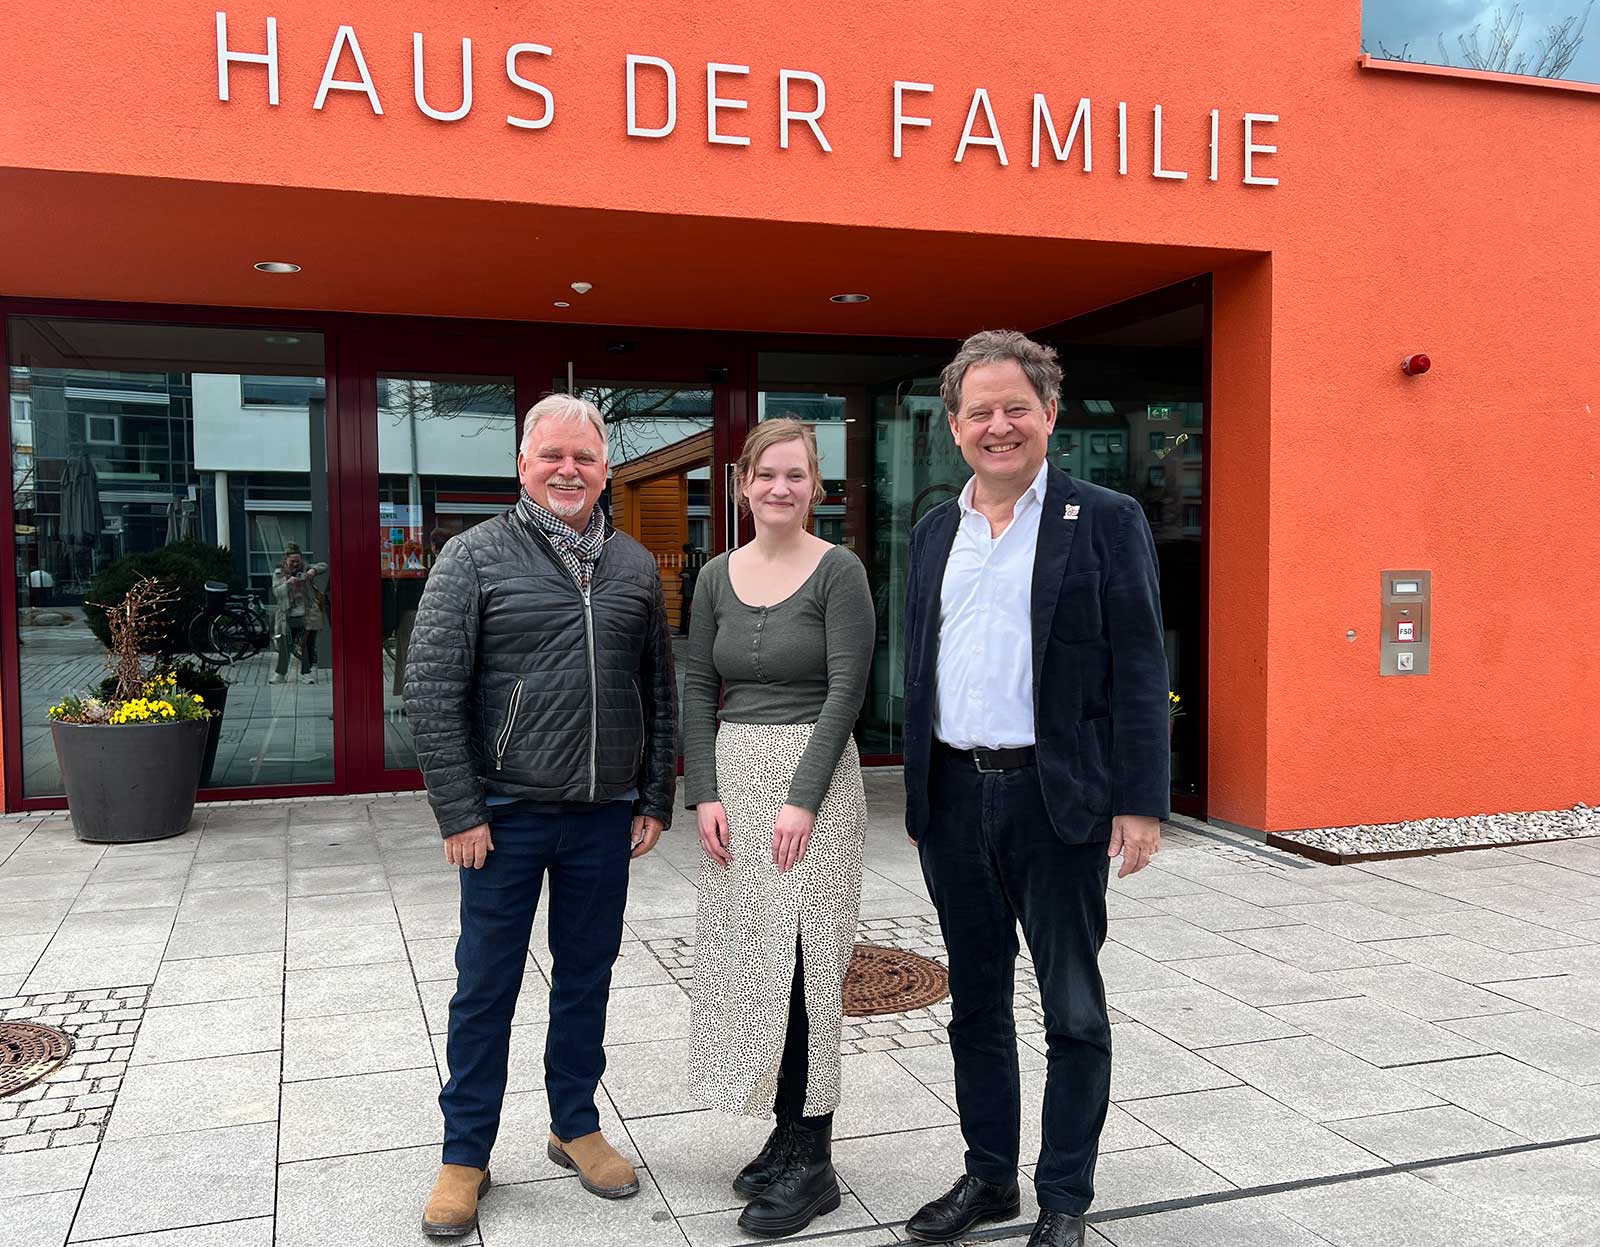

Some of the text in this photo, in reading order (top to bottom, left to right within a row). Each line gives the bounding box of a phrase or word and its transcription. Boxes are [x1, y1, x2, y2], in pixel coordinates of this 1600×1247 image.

[215, 11, 1280, 187] HAUS DER FAMILIE
